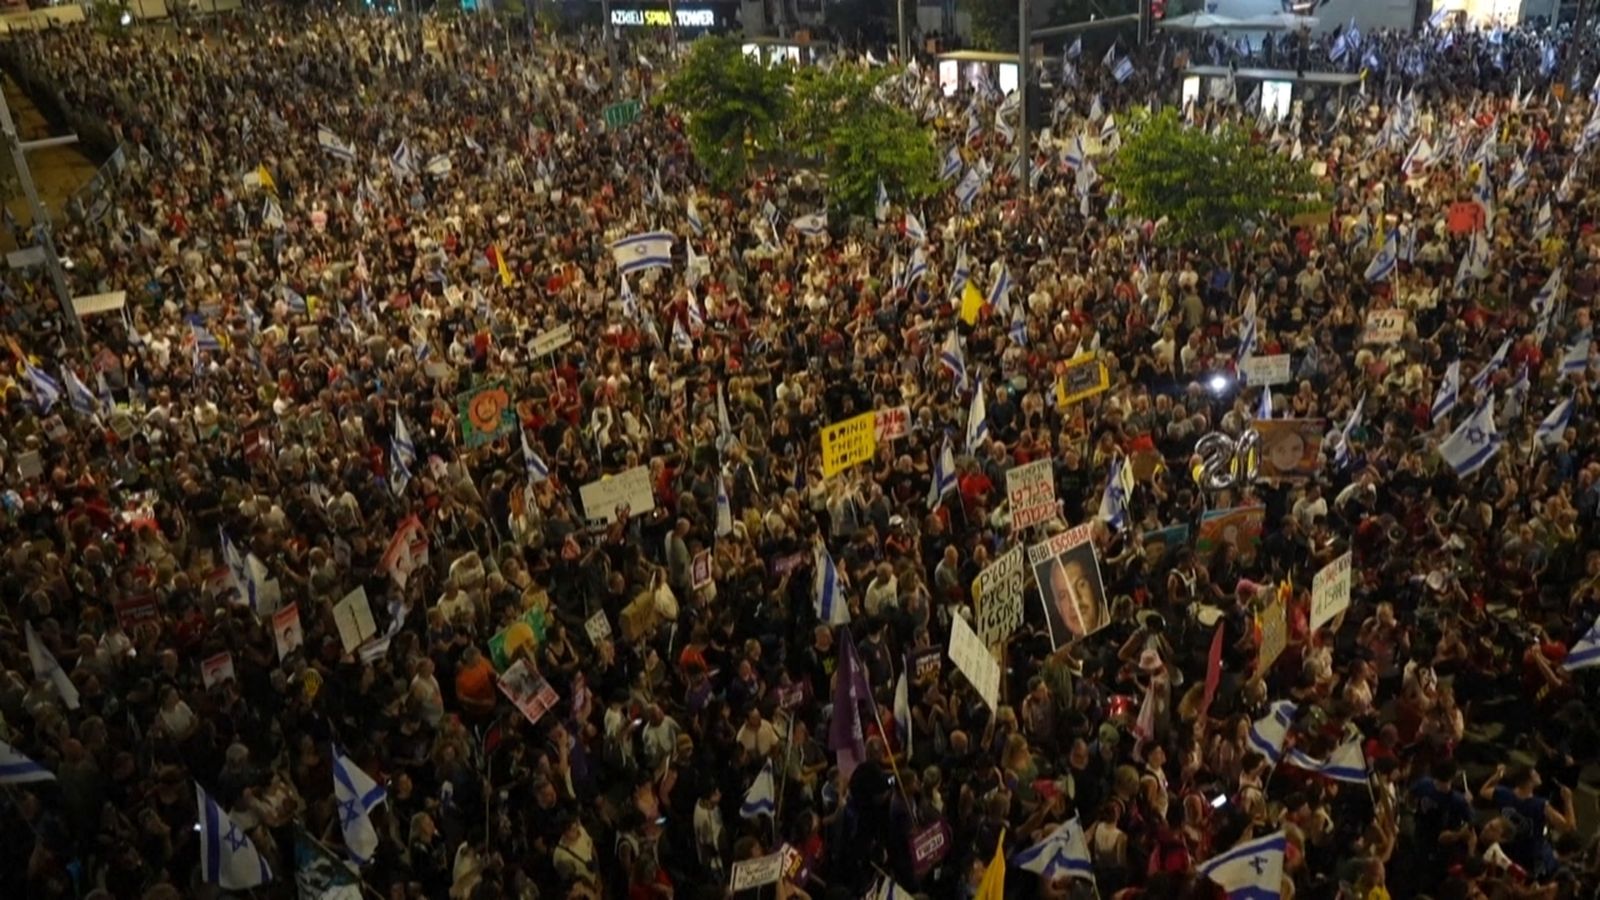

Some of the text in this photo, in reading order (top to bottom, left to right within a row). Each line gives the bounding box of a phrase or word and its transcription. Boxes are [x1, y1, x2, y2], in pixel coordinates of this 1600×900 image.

[645, 10, 676, 26] SPIRA
[676, 10, 714, 26] TOWER
[828, 420, 867, 442] BRING
[1030, 525, 1090, 564] BIBI ESCOBAR
